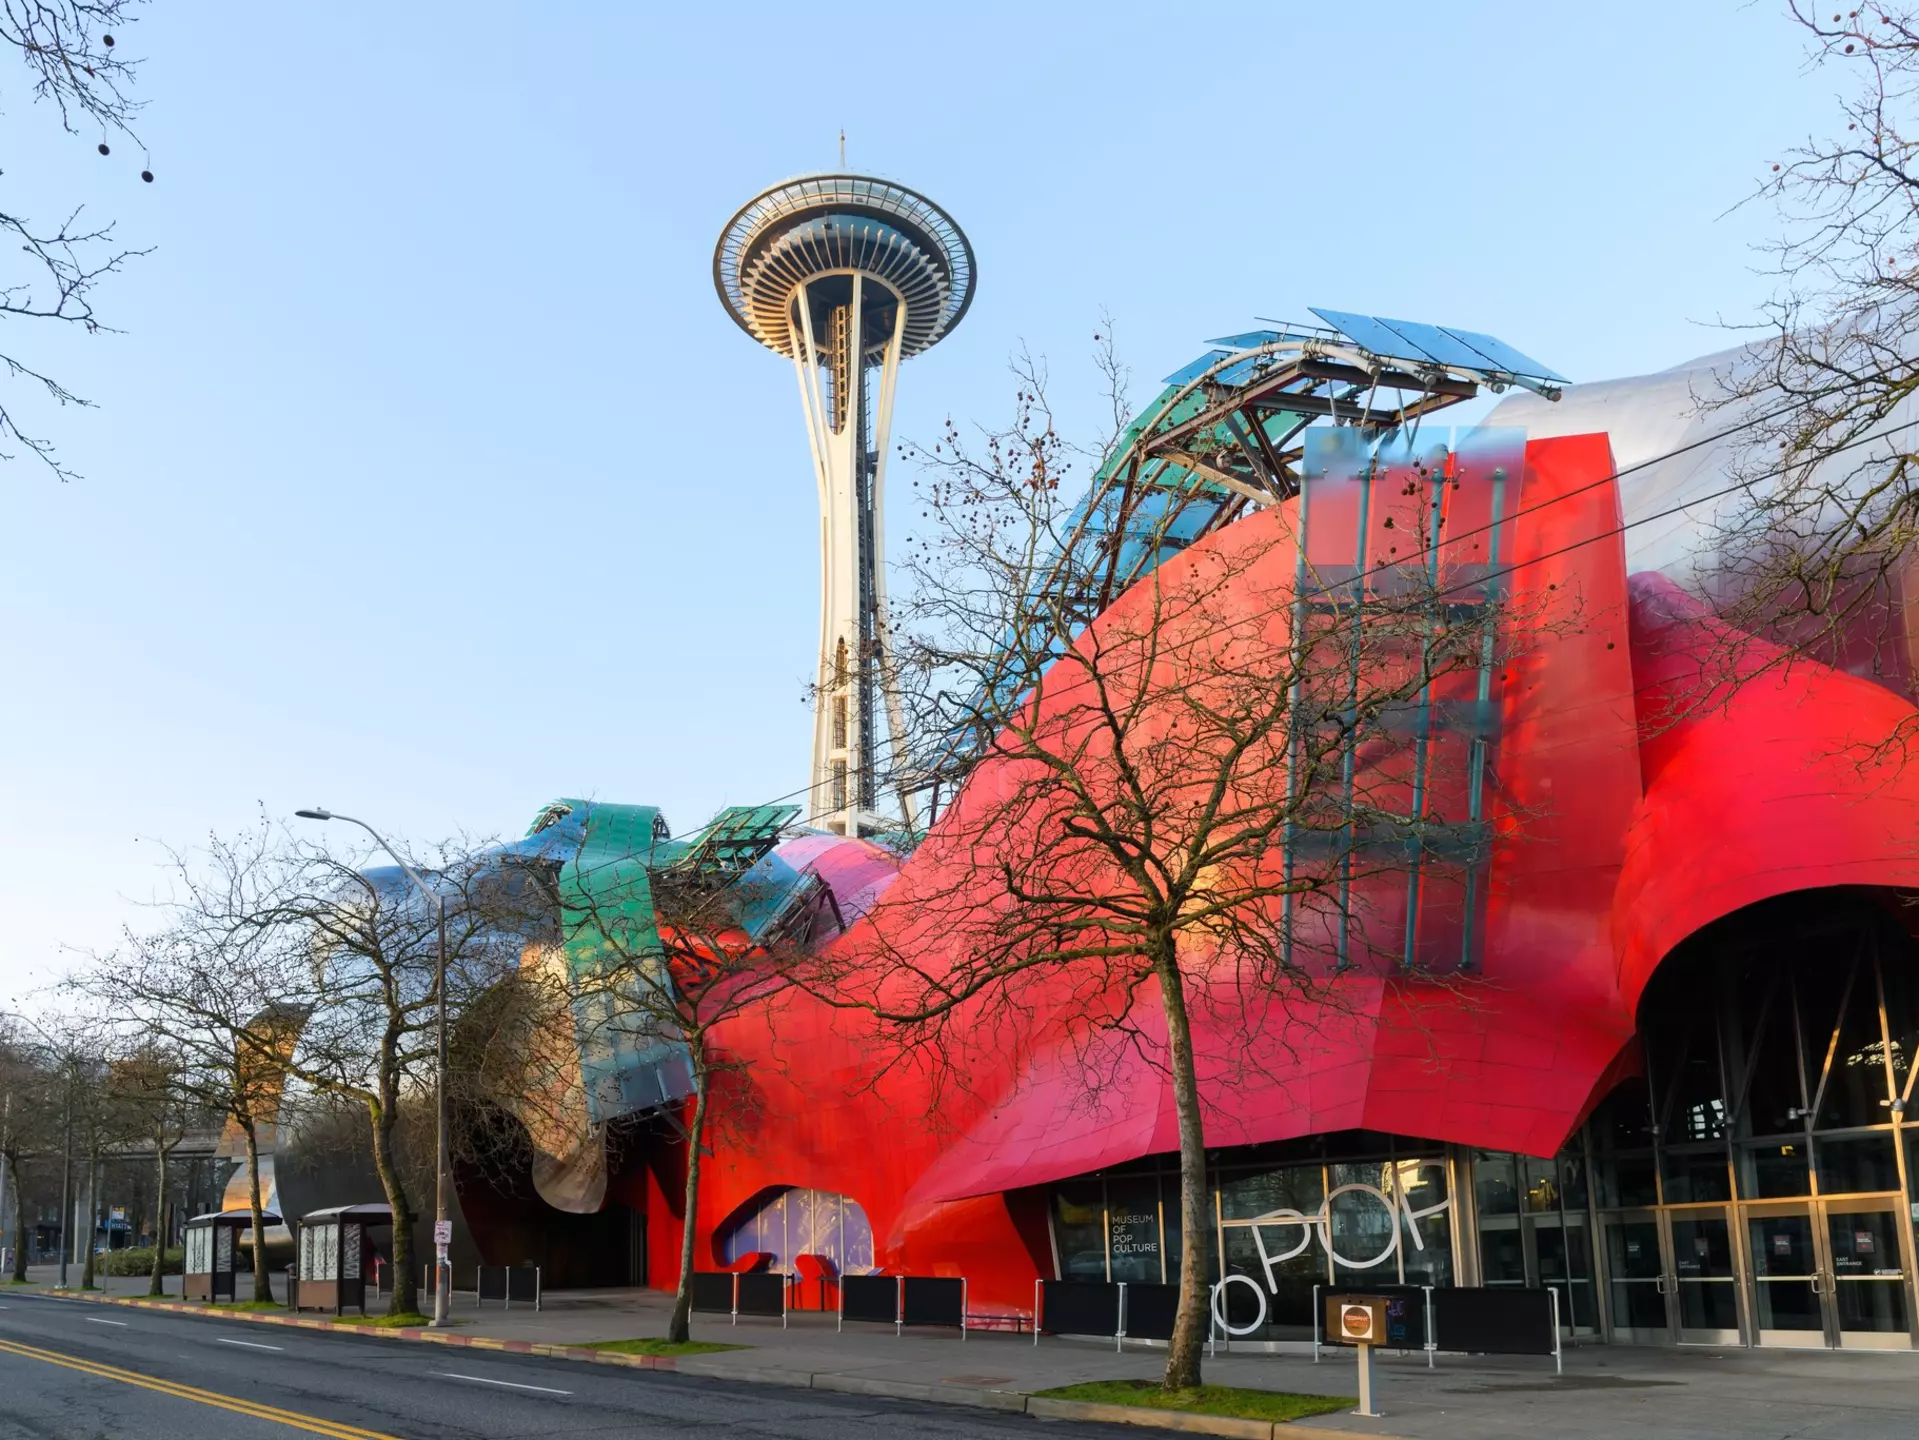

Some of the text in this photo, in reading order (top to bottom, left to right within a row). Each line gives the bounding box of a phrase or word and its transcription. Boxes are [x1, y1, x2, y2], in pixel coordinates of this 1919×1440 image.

[1112, 1214, 1154, 1224] MUSEUM
[1112, 1225, 1126, 1234] OF
[1113, 1234, 1133, 1244] POP
[1113, 1243, 1158, 1253] CULTURE
